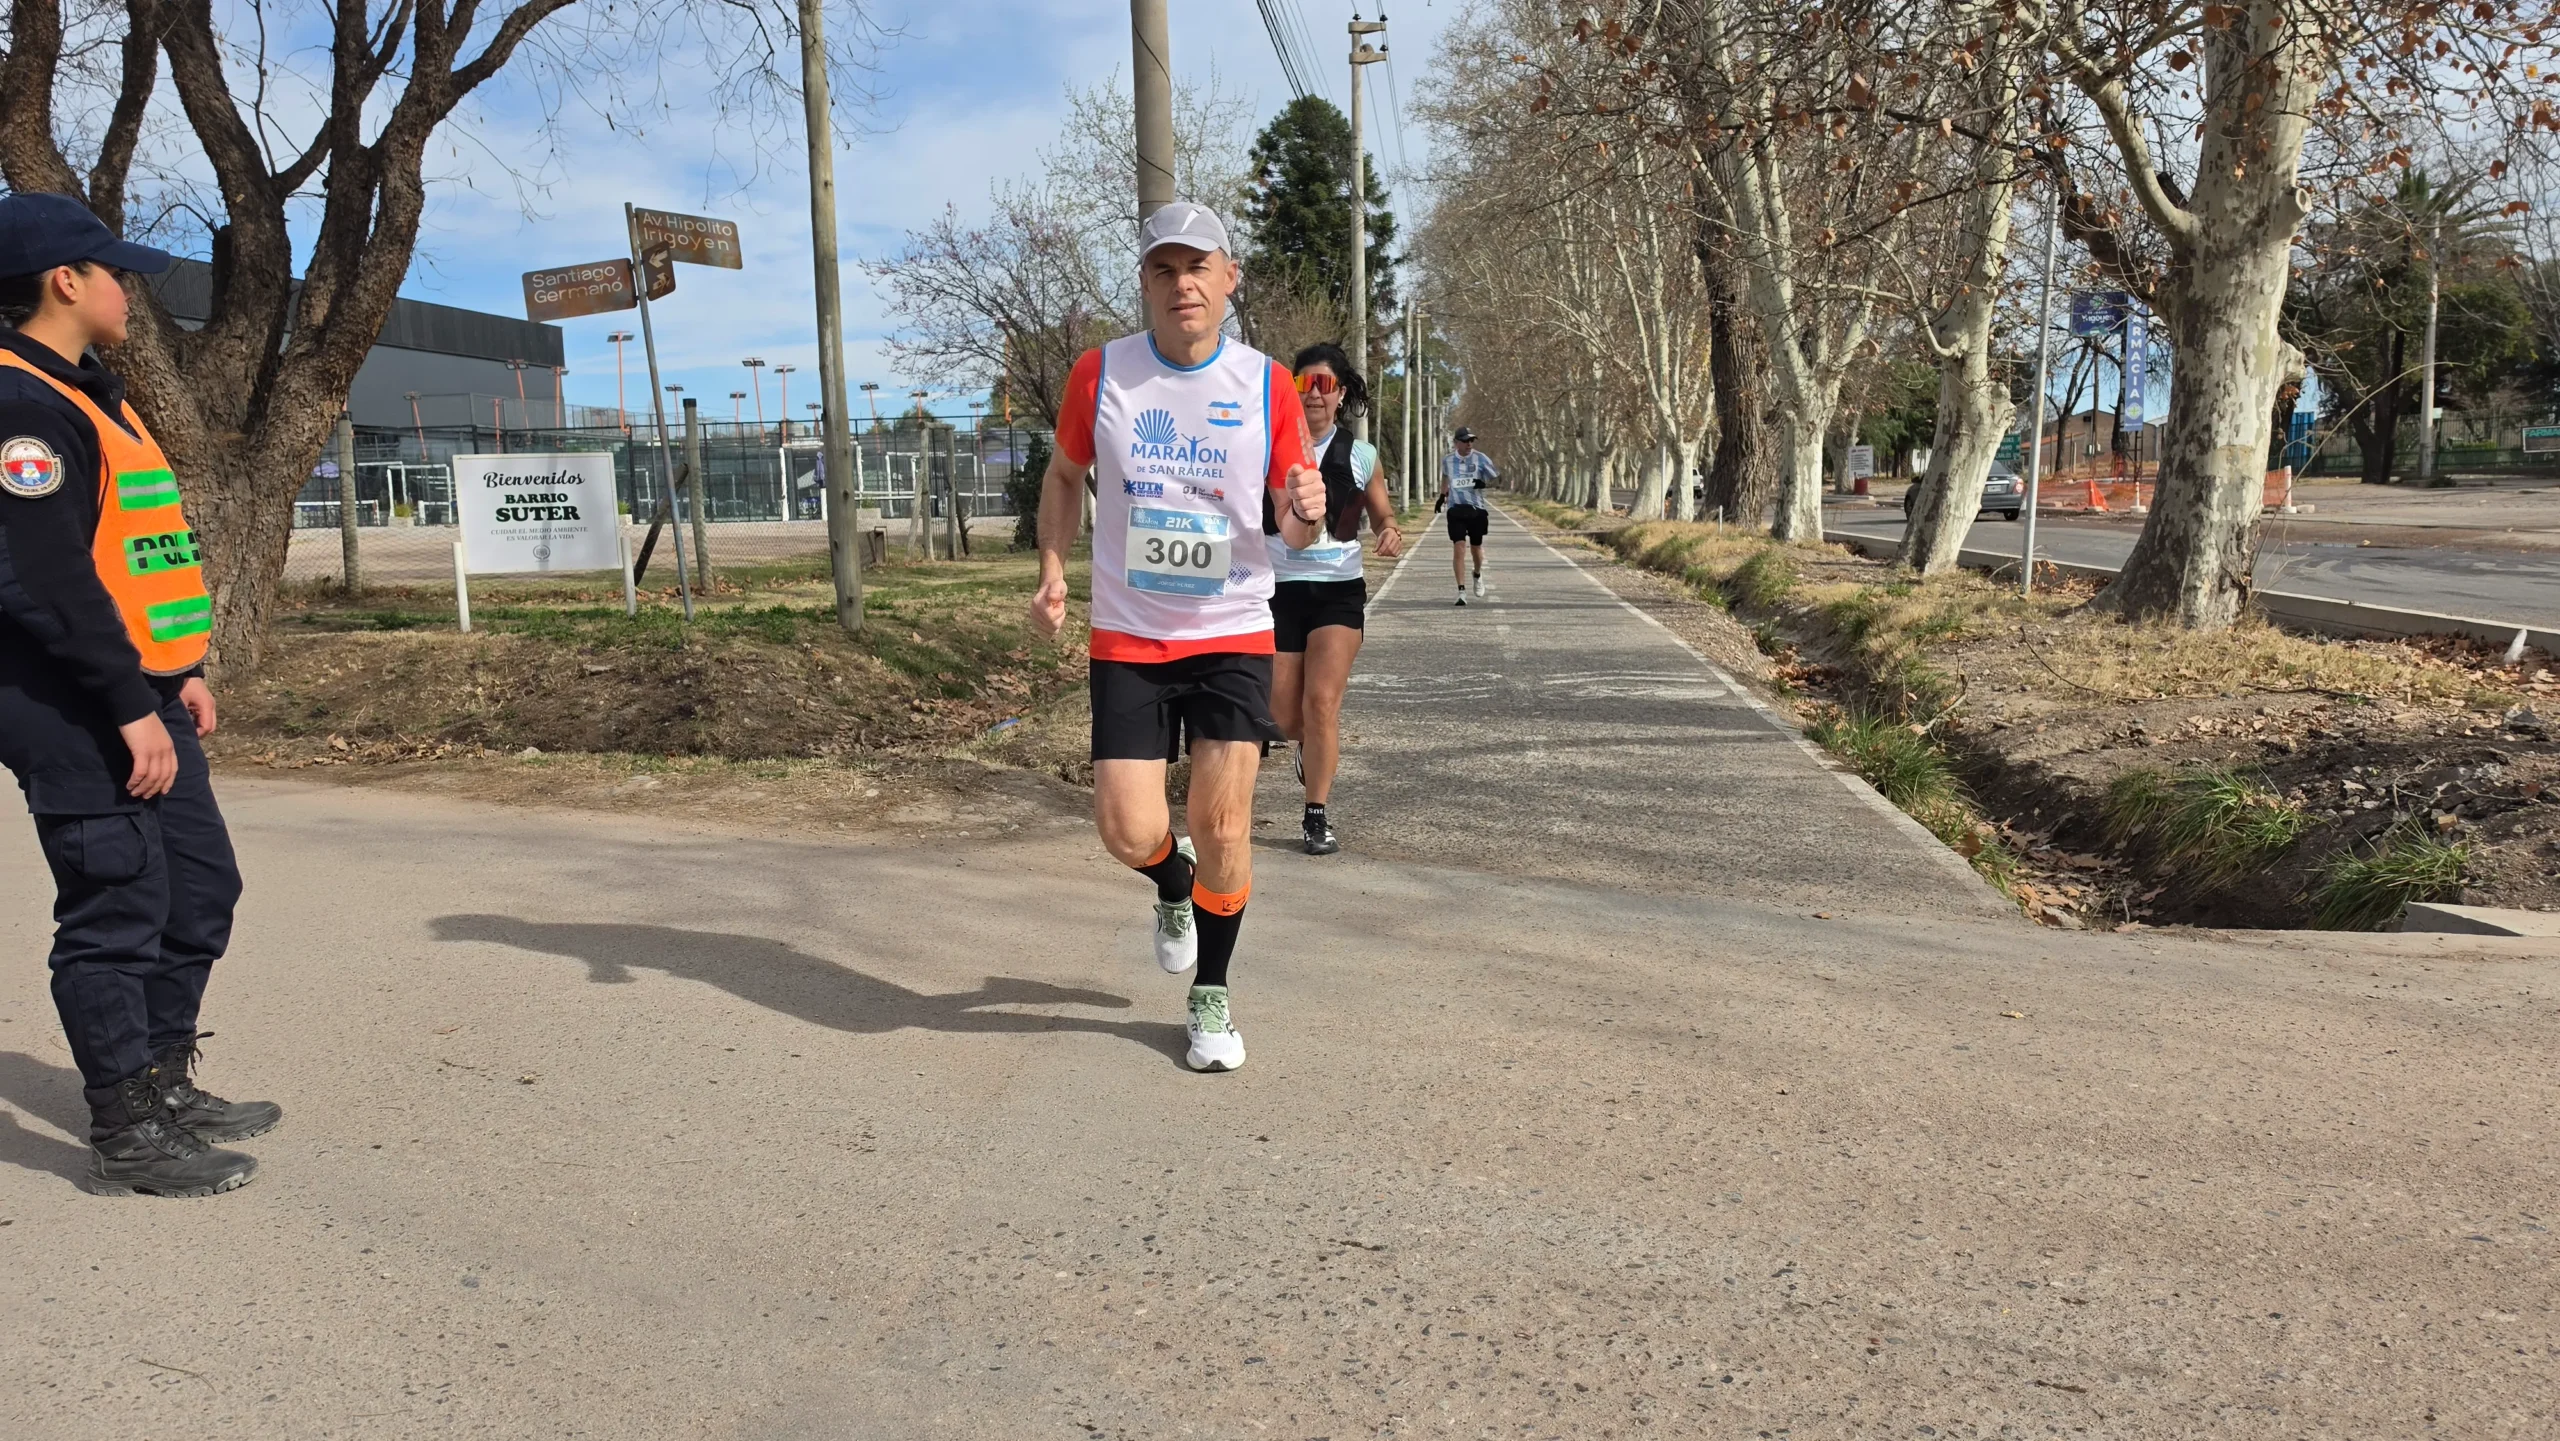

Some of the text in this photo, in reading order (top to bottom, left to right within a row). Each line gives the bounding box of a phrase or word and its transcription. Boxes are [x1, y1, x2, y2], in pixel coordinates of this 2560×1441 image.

[666, 216, 733, 237] Hipolito
[644, 228, 729, 251] Irigoyen
[532, 266, 616, 288] Santiago
[534, 277, 623, 304] Germanó
[483, 469, 586, 489] Bienvenidos
[1136, 464, 1225, 478] DE SAN RAFAEL
[1137, 481, 1164, 492] UTN
[504, 493, 569, 505] BARRIO
[495, 505, 581, 522] SUTER
[1164, 516, 1194, 530] 21K
[1145, 537, 1212, 569] 300
